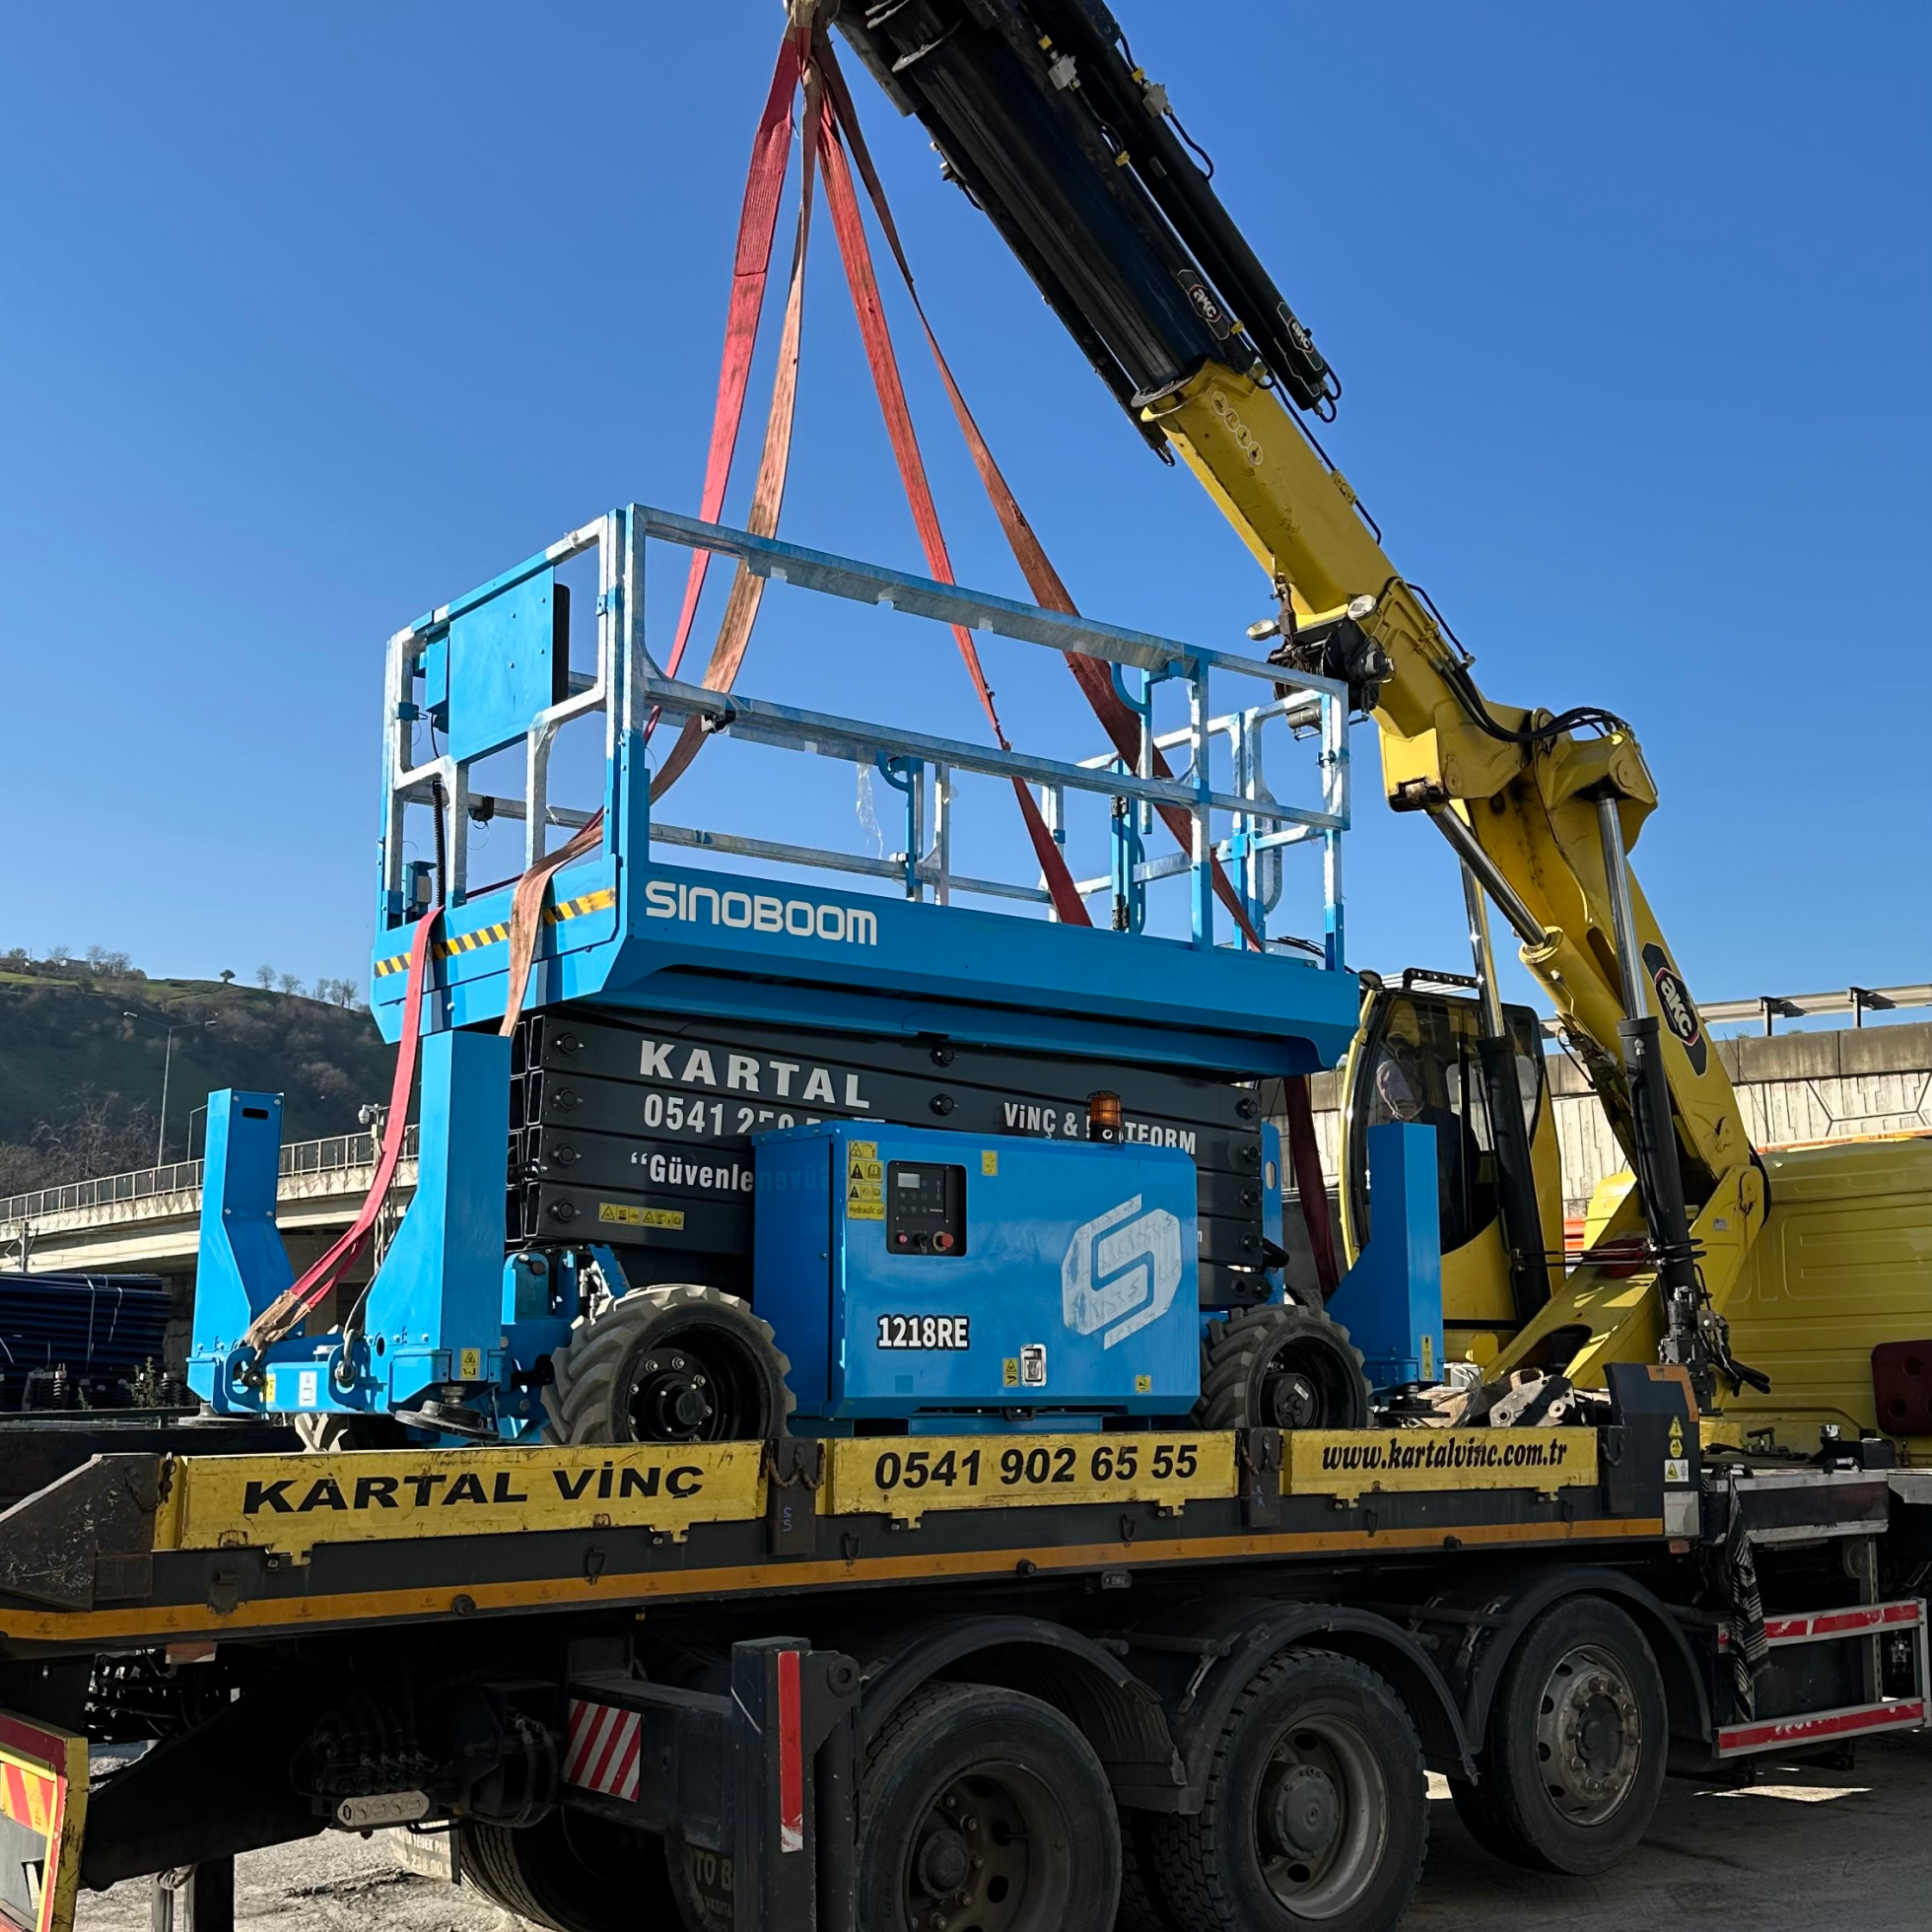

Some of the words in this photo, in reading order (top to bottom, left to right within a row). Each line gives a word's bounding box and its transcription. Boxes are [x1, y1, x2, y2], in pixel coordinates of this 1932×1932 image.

[645, 881, 878, 946] SINOBOOM
[640, 1040, 870, 1109] KARTAL
[644, 1093, 724, 1136] 0541
[1063, 1112, 1078, 1138] &
[877, 1316, 969, 1348] 1218RE
[874, 1449, 981, 1489] 0541
[1000, 1447, 1076, 1484] 902
[1090, 1445, 1139, 1481] 65
[1150, 1444, 1199, 1480] 55
[1322, 1436, 1568, 1471] www.kartalvinc.com.tr
[242, 1470, 528, 1515] KARTAL
